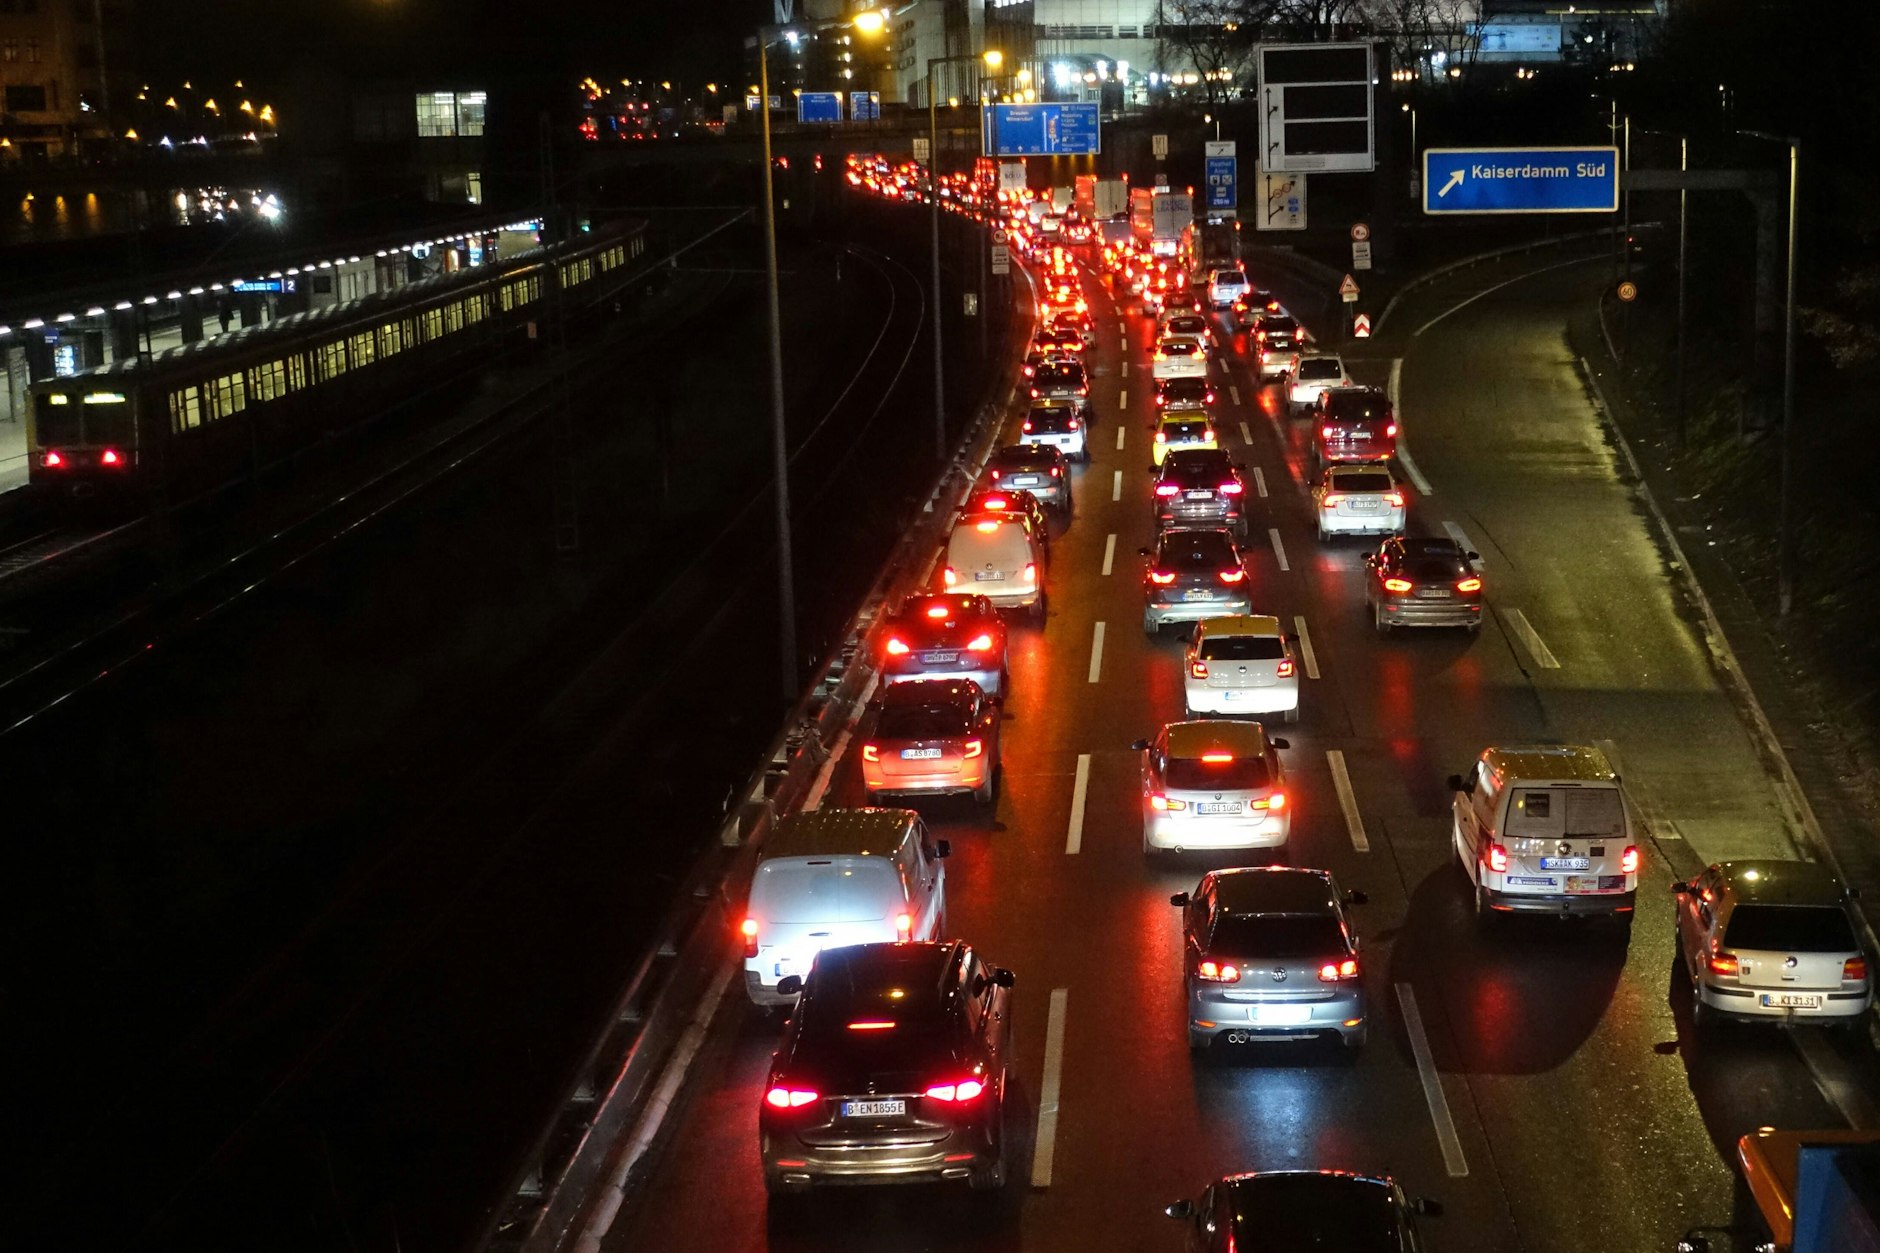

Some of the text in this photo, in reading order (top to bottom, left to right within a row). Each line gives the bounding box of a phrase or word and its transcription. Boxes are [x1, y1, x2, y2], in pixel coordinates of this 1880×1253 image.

[1472, 163, 1606, 179] Kaiserdamm Süd
[287, 280, 295, 291] 2
[1623, 287, 1633, 296] 60
